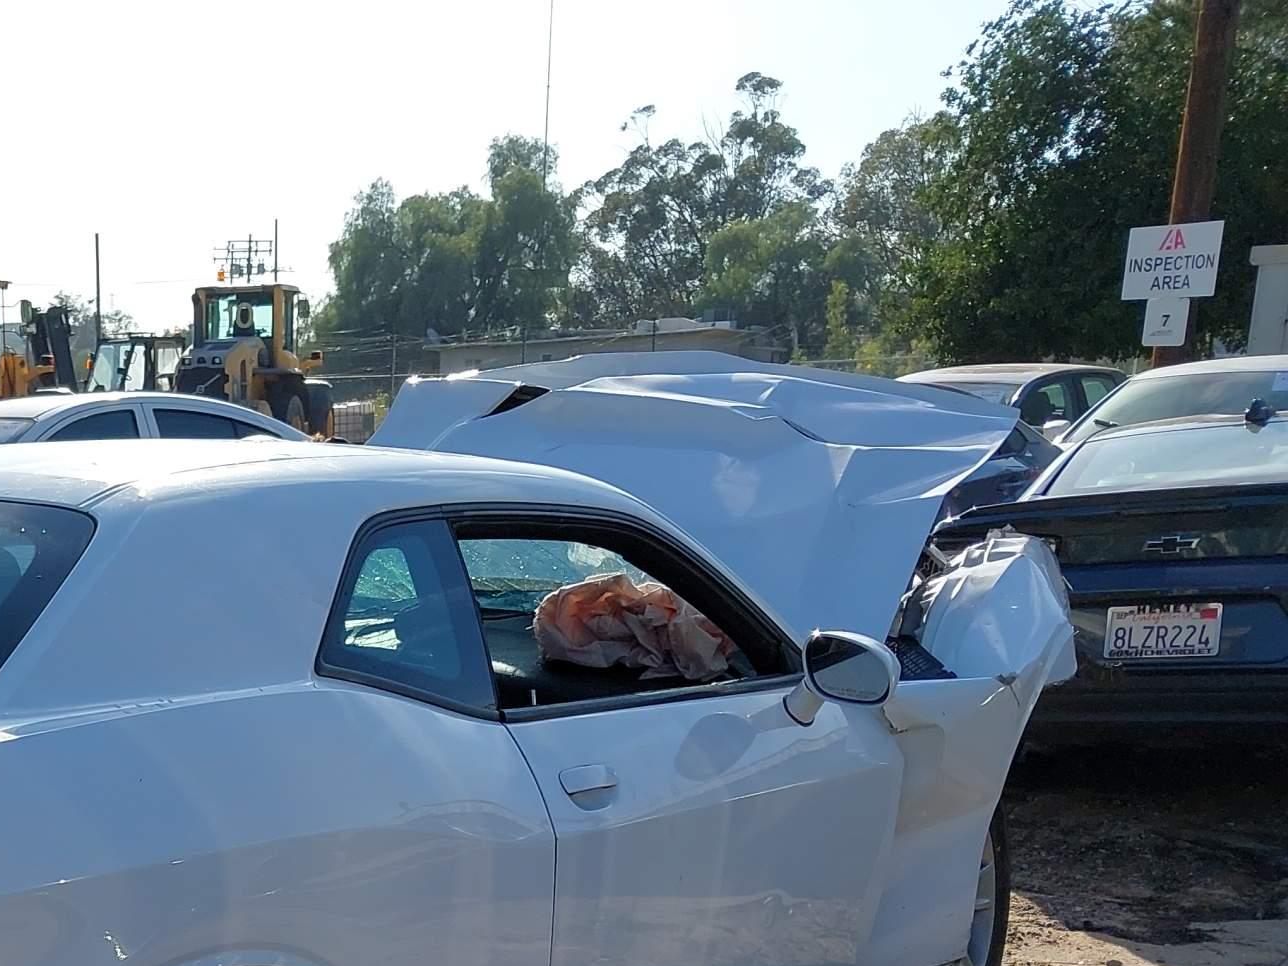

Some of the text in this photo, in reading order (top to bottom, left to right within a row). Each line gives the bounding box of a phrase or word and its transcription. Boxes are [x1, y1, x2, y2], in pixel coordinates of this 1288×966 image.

[1128, 253, 1216, 273] INSPECTION
[1150, 275, 1191, 291] AREA
[1162, 314, 1171, 327] 7
[1113, 624, 1210, 649] 8LZR224
[1144, 648, 1212, 656] CHEVROLET
